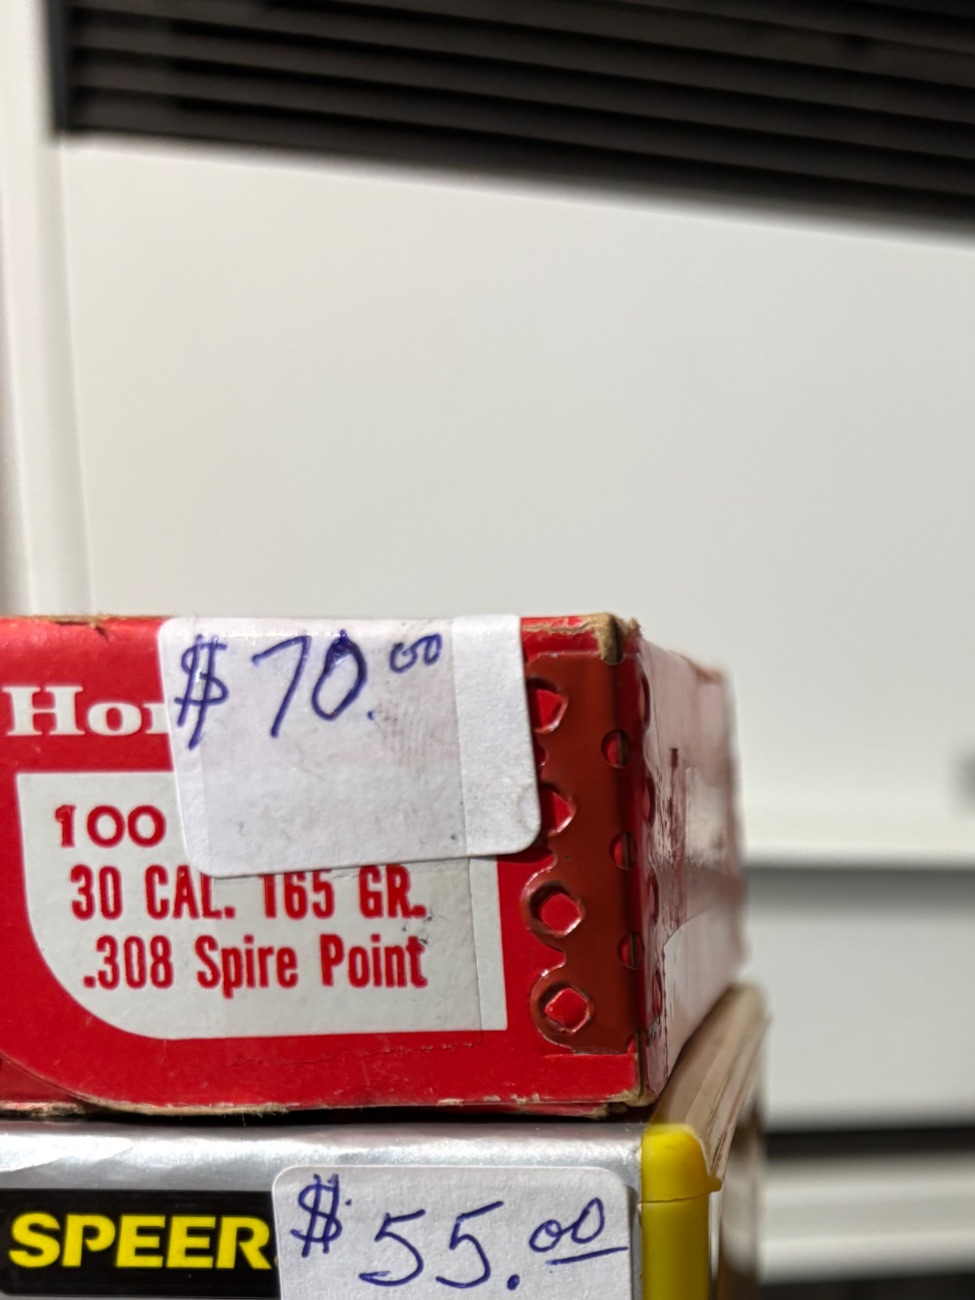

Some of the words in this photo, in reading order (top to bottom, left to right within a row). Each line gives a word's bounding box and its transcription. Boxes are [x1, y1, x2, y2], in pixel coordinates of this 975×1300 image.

[54, 804, 167, 849] 100
[70, 864, 123, 920] 30
[145, 864, 236, 920] CAL.
[259, 868, 335, 920] 165
[358, 865, 428, 920] GR.
[83, 934, 174, 990] .308
[195, 934, 299, 999] Spire
[320, 933, 429, 989] Point
[8, 1211, 272, 1271] SPEER
